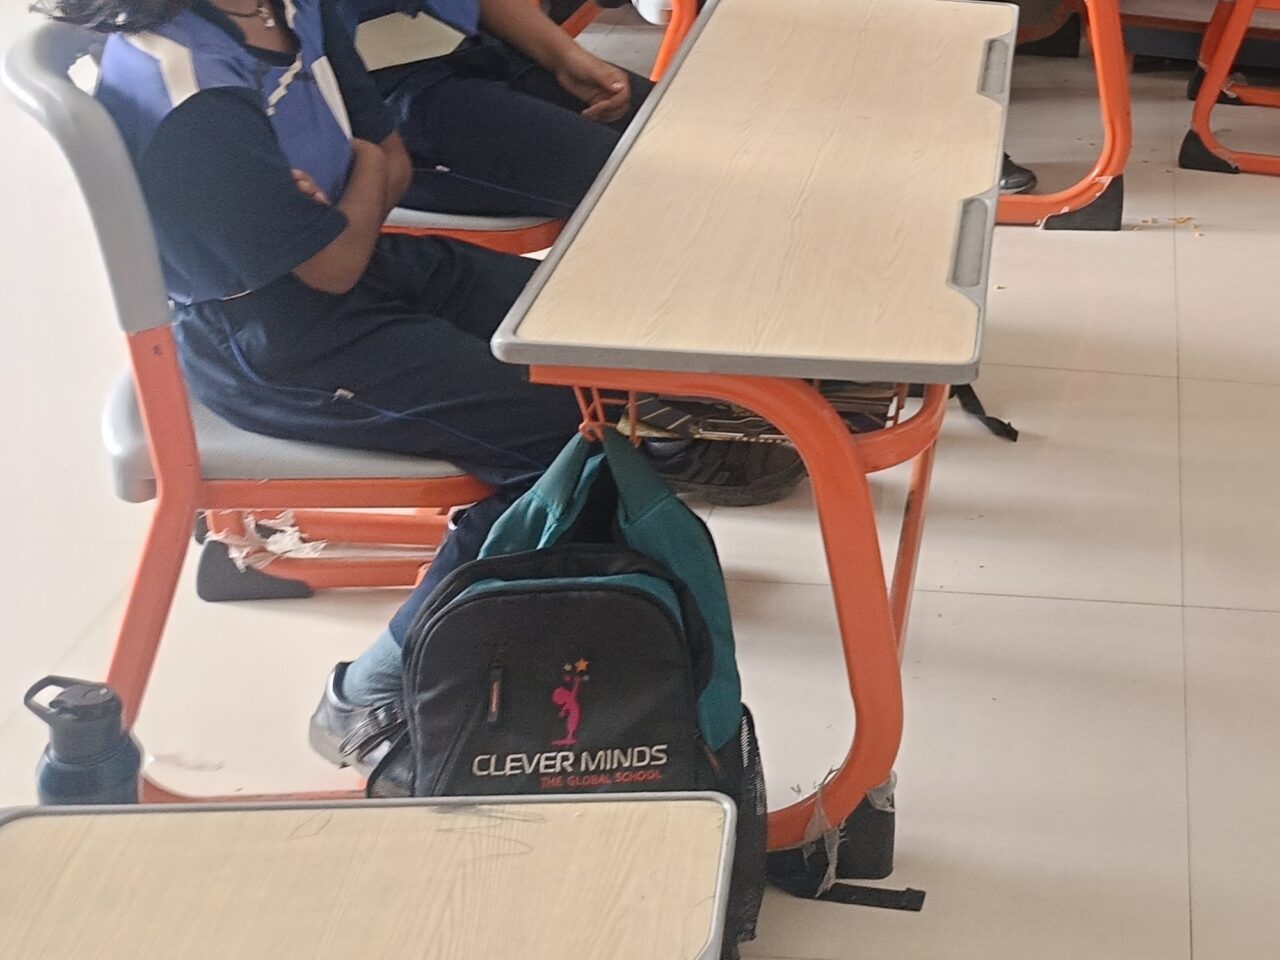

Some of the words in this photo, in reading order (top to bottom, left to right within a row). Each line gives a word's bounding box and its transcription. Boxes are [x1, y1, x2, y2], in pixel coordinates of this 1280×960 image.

[472, 751, 575, 776] CLEVER
[580, 744, 668, 772] MINDS
[541, 776, 563, 789] THE
[567, 772, 611, 787] GLOBAL
[615, 770, 662, 784] SCHOOL
